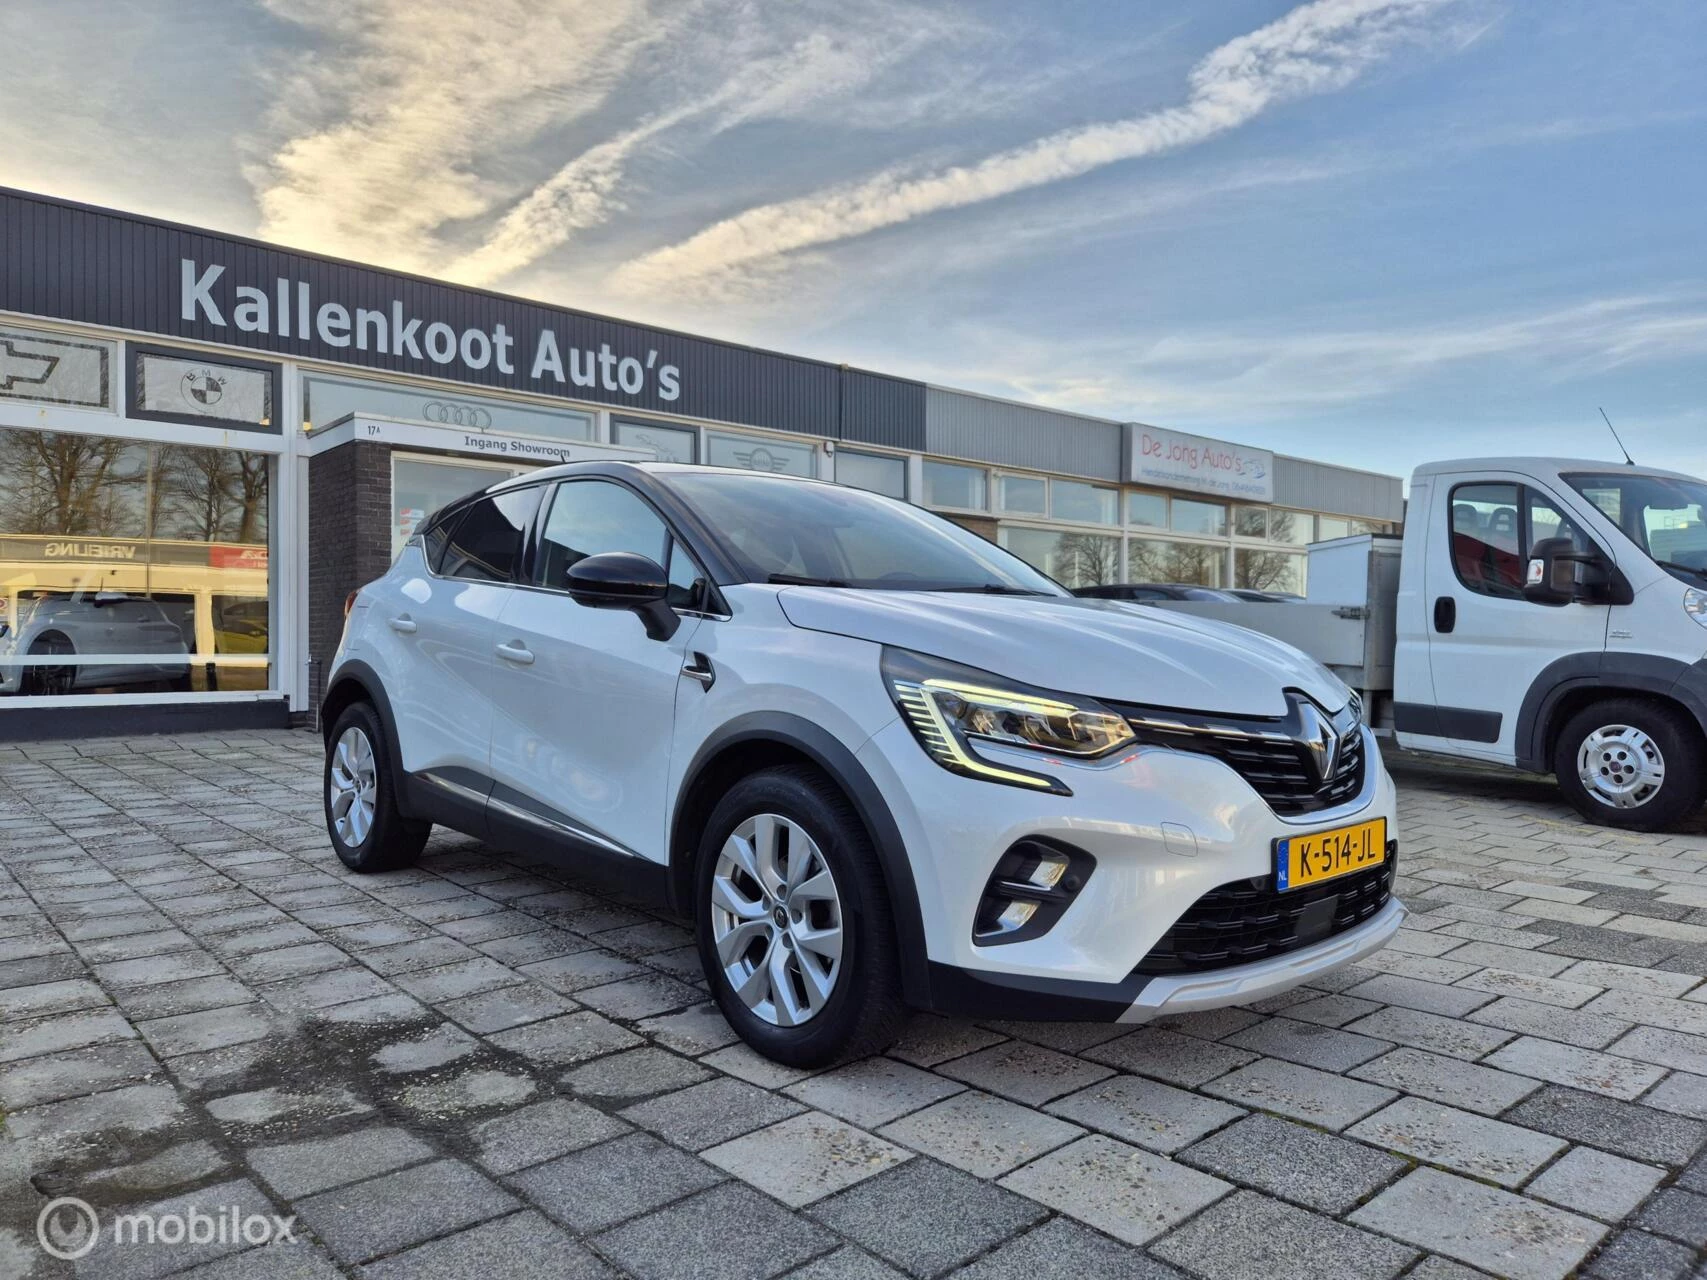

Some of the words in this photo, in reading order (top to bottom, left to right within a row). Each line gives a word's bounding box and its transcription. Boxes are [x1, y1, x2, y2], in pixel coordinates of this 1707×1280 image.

[181, 258, 515, 375] Kallenkoot
[530, 329, 680, 401] Auto's
[464, 435, 508, 453] Ingang
[510, 440, 570, 458] Showroom
[1141, 433, 1162, 457] De
[1165, 439, 1197, 470] Jong
[1200, 448, 1243, 473] Auto's
[1300, 828, 1376, 878] K-514-JL
[1278, 871, 1288, 881] NL
